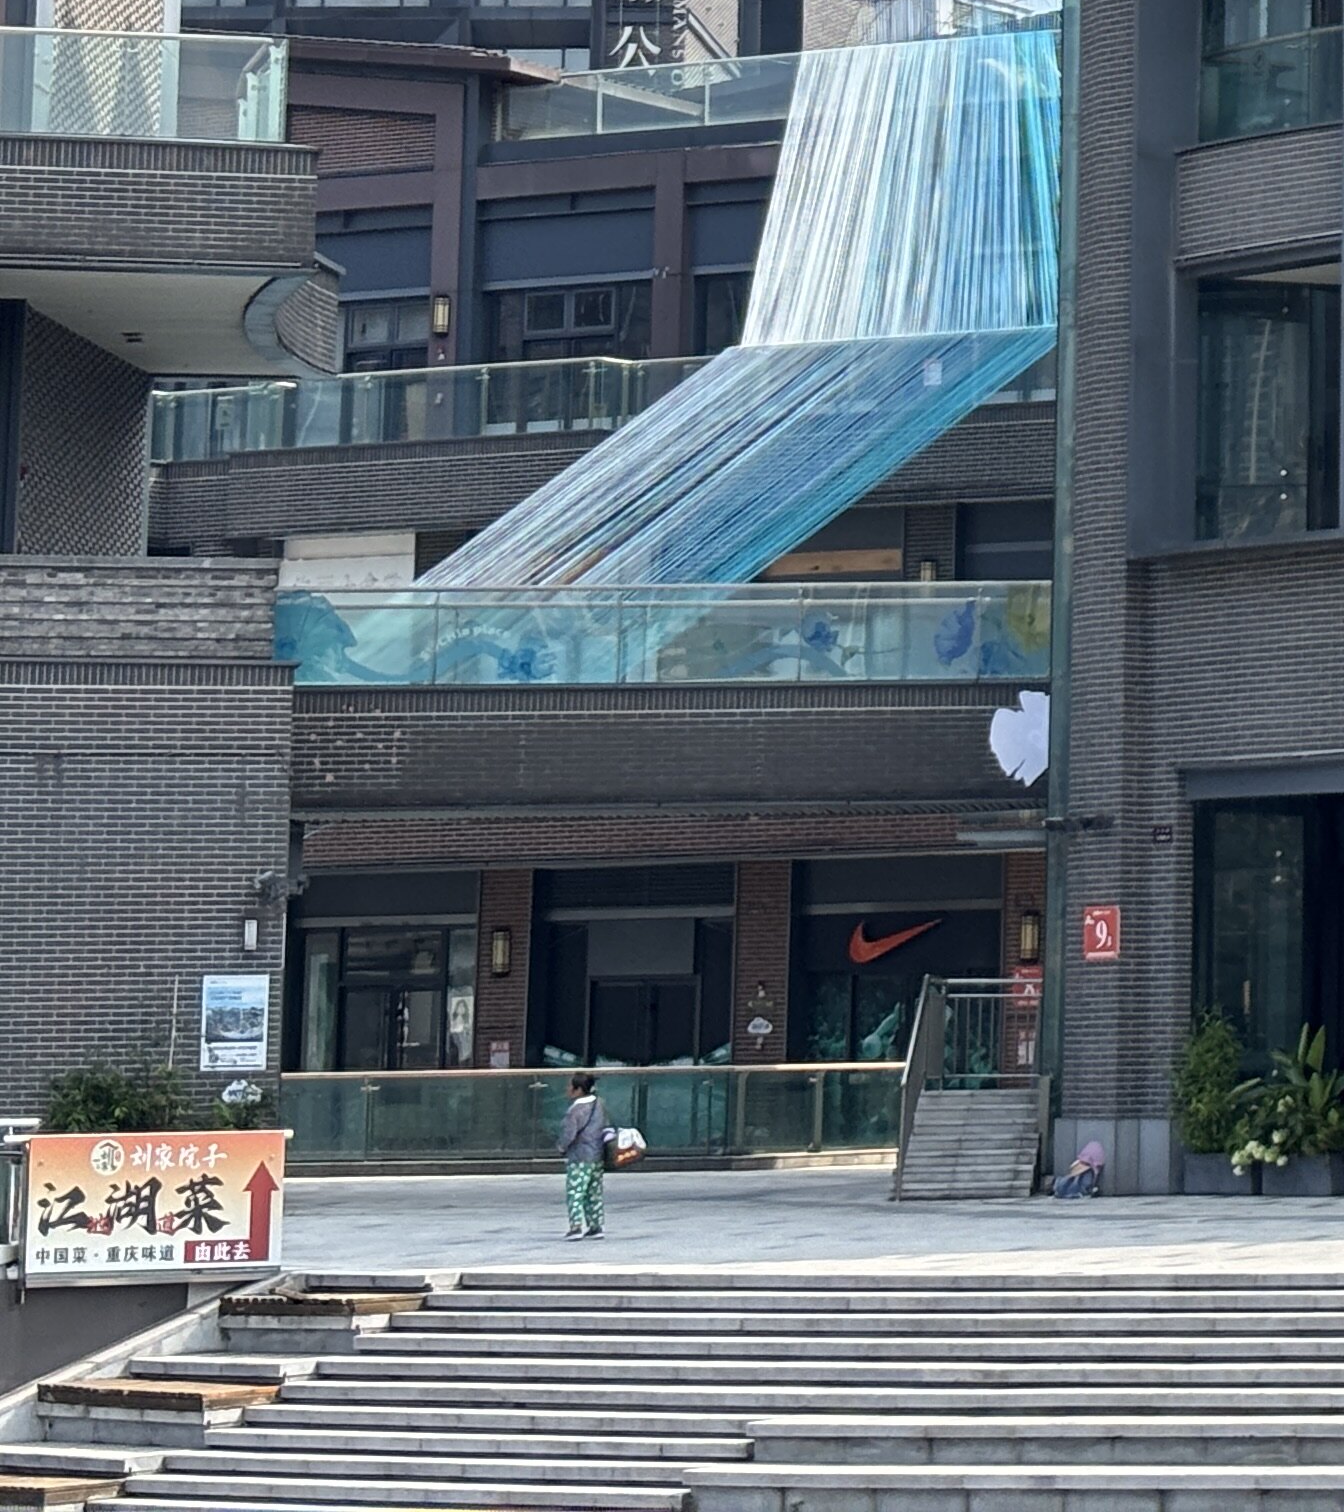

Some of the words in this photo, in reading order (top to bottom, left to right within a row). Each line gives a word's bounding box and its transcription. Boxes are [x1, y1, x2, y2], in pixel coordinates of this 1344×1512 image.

[129, 1142, 228, 1172] 刘家院子
[37, 1173, 230, 1236] 江湖菜
[194, 1240, 252, 1262] 由此去
